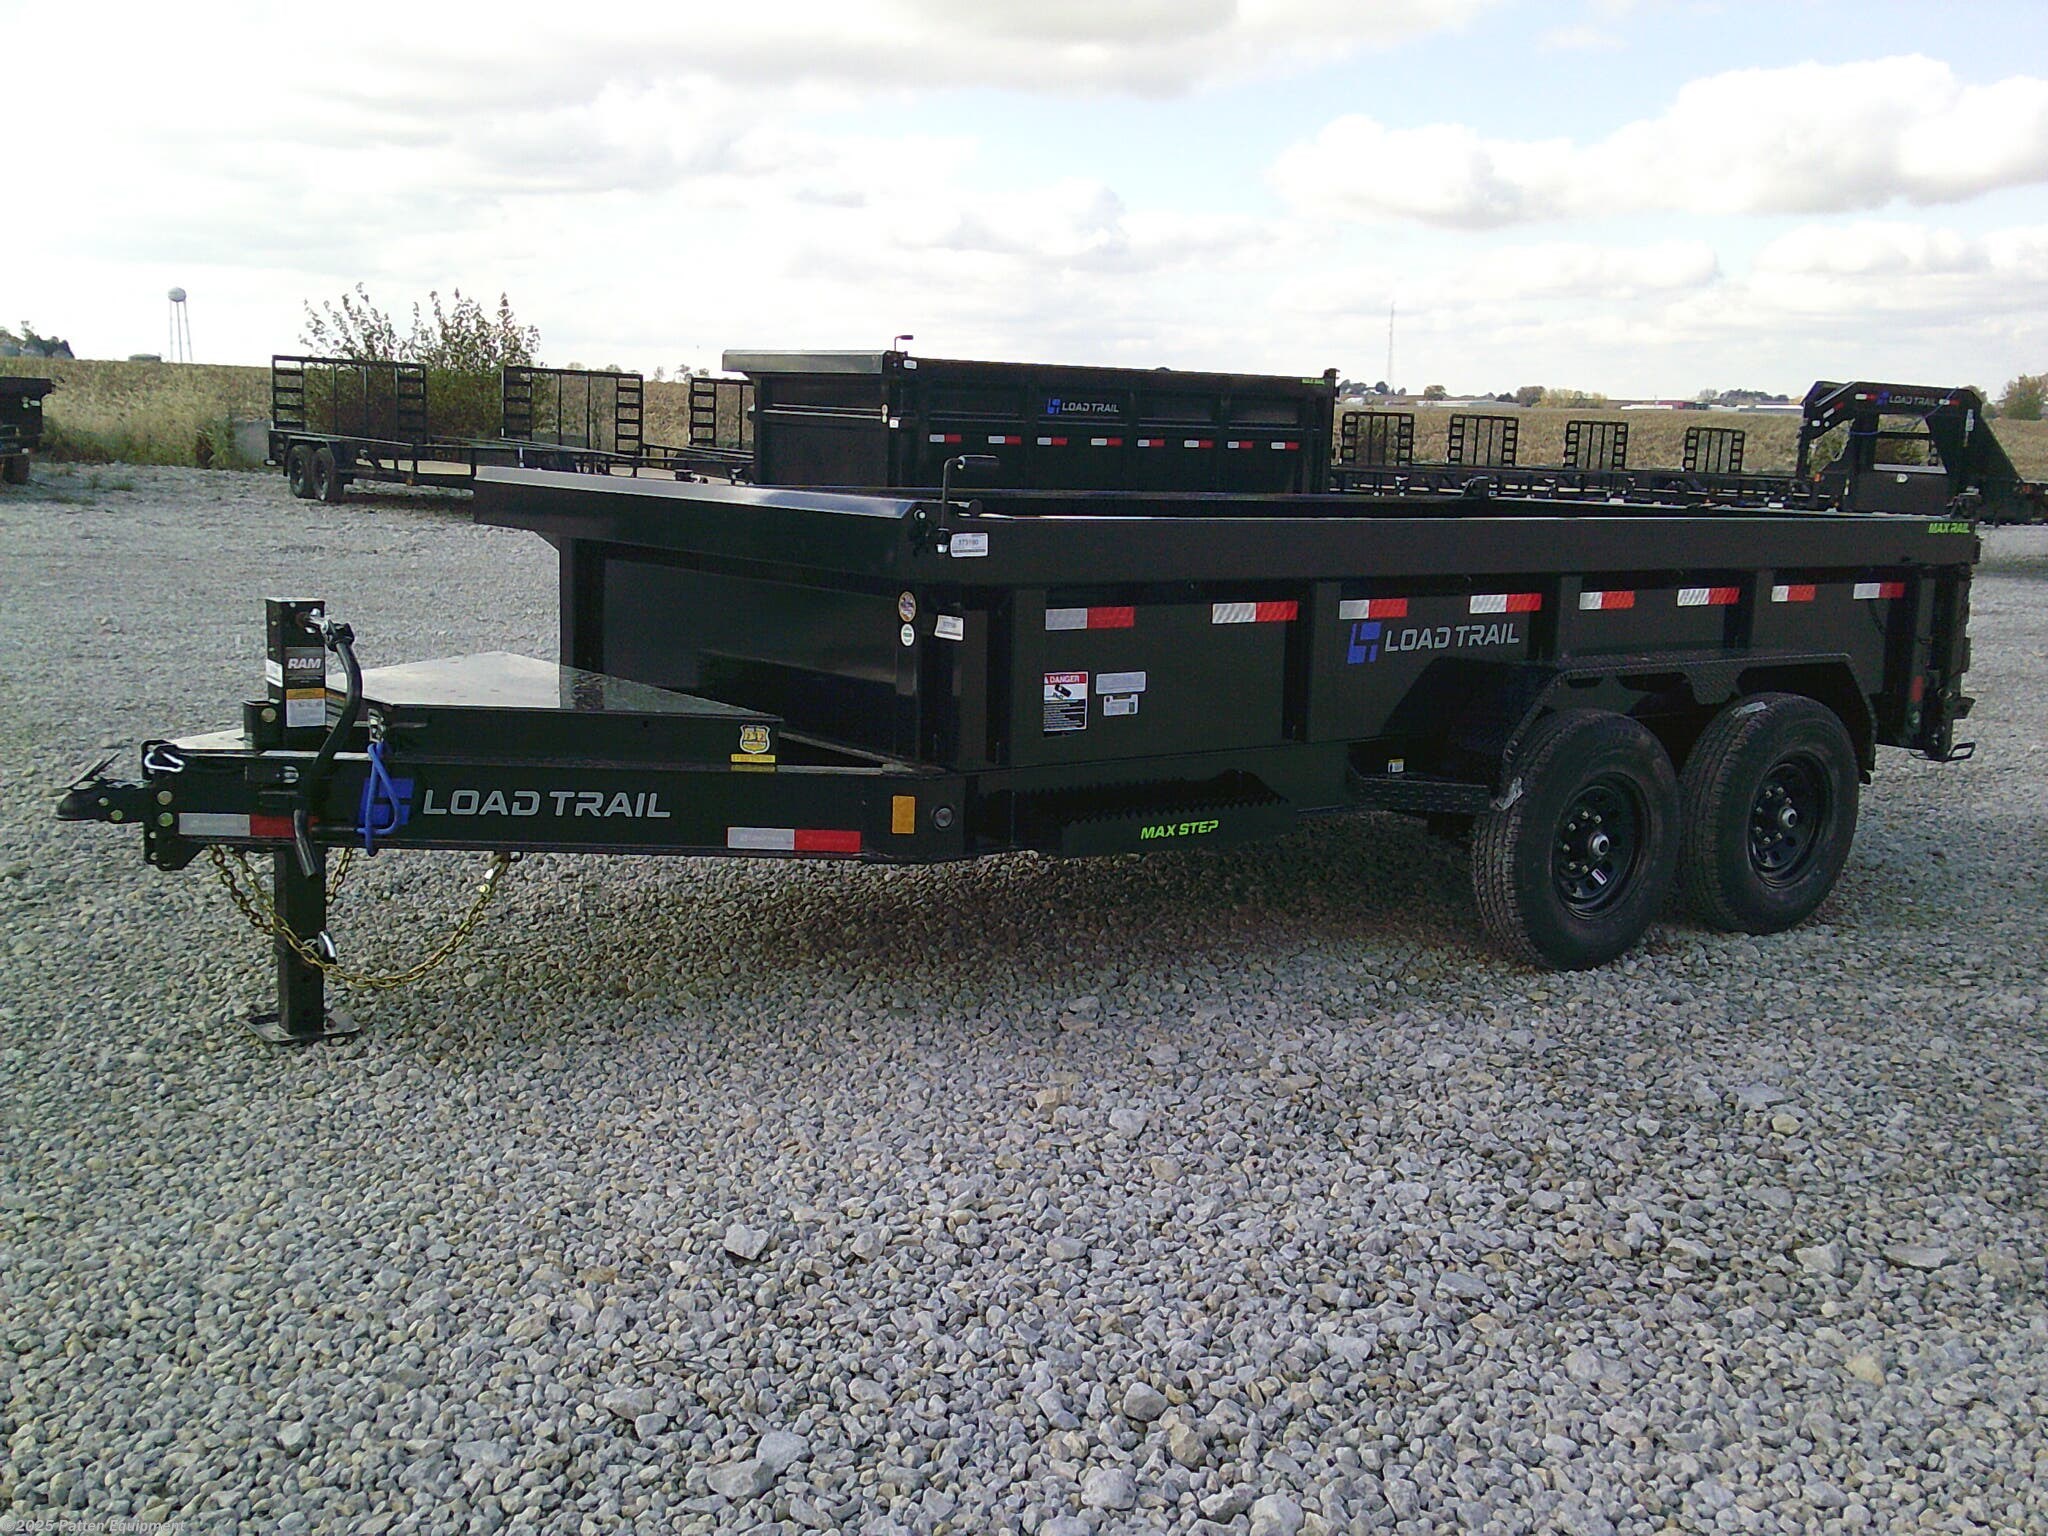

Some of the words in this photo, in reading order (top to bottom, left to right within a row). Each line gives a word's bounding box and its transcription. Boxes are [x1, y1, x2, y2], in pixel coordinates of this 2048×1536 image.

[1062, 402, 1090, 411] LOAD
[1091, 403, 1120, 413] TRAIL
[1928, 522, 1950, 534] MAX
[1385, 626, 1451, 652] LOAD
[1455, 623, 1520, 648] TRAIL
[287, 658, 321, 669] RAM
[1049, 675, 1080, 684] DANGER
[423, 789, 541, 816] LOAD
[549, 791, 671, 818] TRAIL
[1140, 823, 1177, 840] MAX
[1178, 820, 1219, 836] STEP
